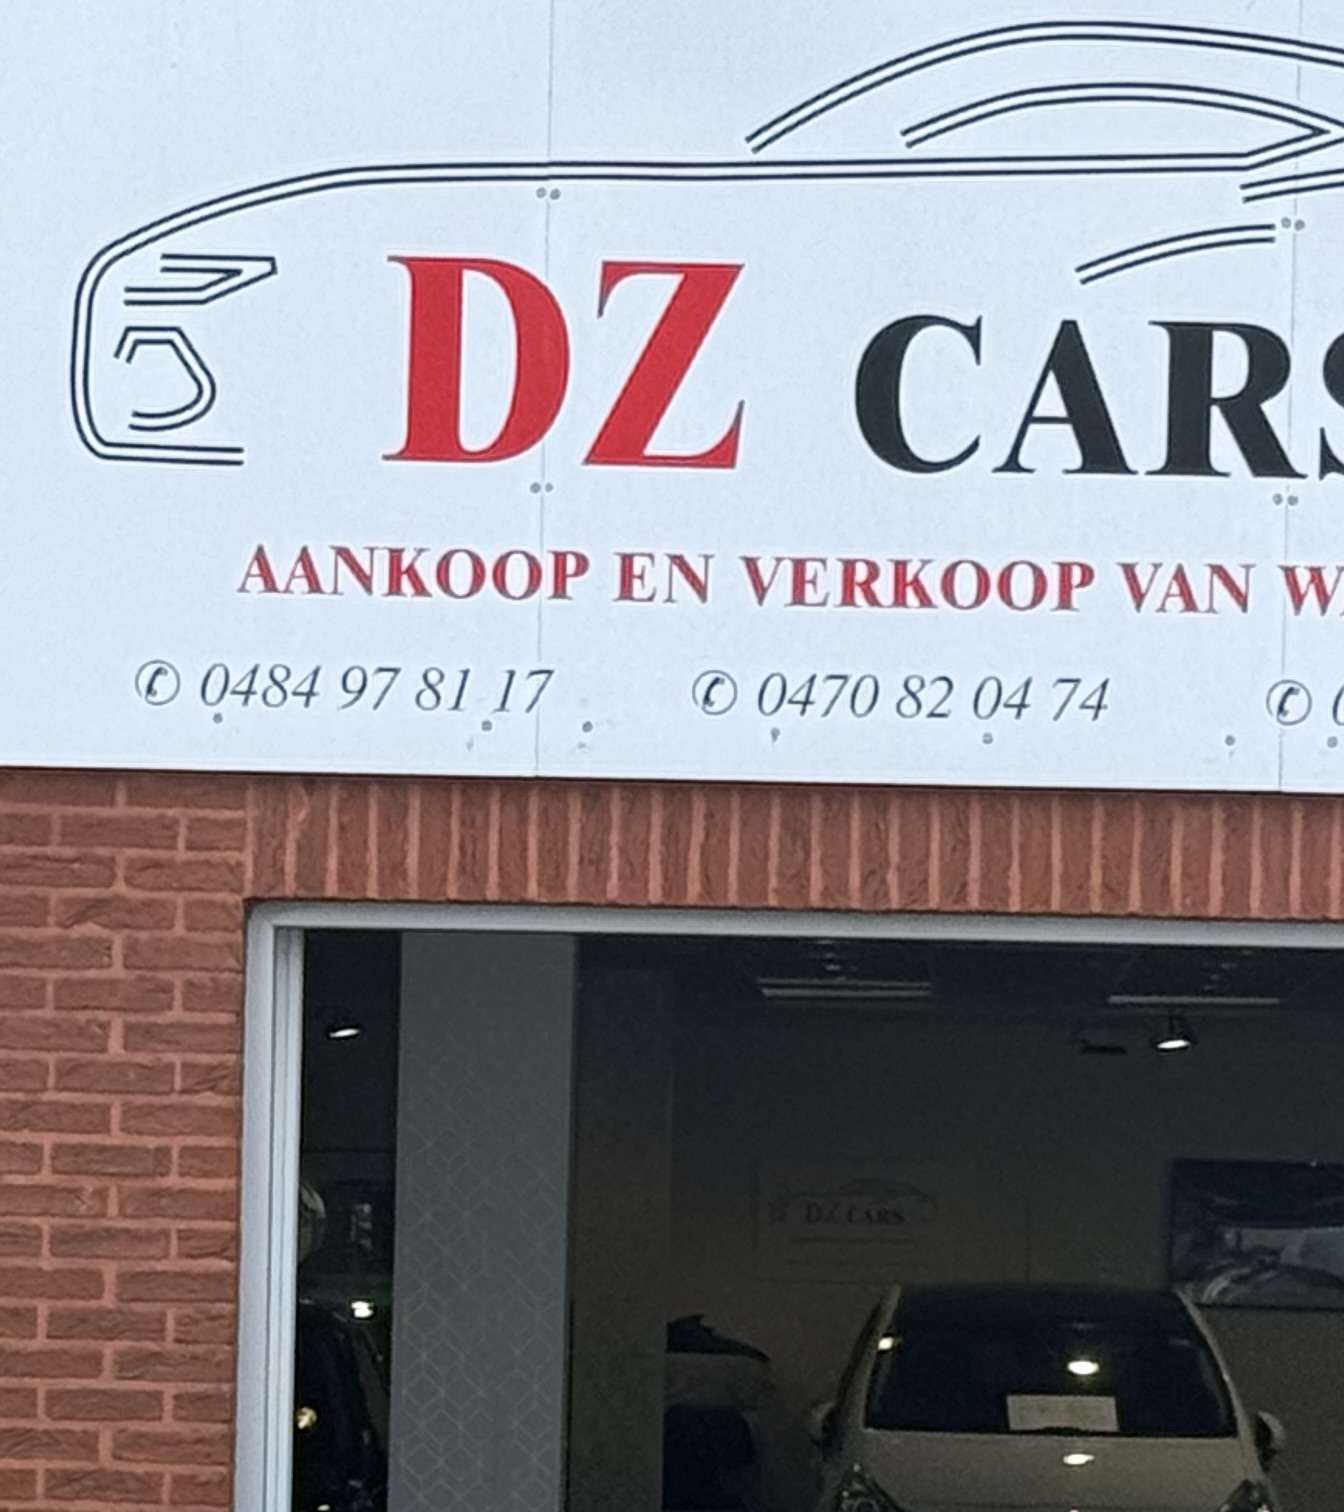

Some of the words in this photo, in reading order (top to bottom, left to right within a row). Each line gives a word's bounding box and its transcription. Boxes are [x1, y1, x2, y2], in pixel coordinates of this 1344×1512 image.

[383, 256, 745, 468] DZ
[238, 545, 589, 600] AANKOOP
[614, 553, 713, 603] EN
[740, 556, 1094, 611] VERKOOP
[1118, 563, 1255, 613] VAN
[201, 664, 320, 708] 0484
[342, 666, 401, 710] 97
[415, 668, 470, 710] 81
[494, 669, 554, 713] 17
[758, 673, 879, 717] 0470
[896, 675, 953, 718] 82
[973, 677, 1032, 719] 04
[1053, 678, 1109, 721] 74
